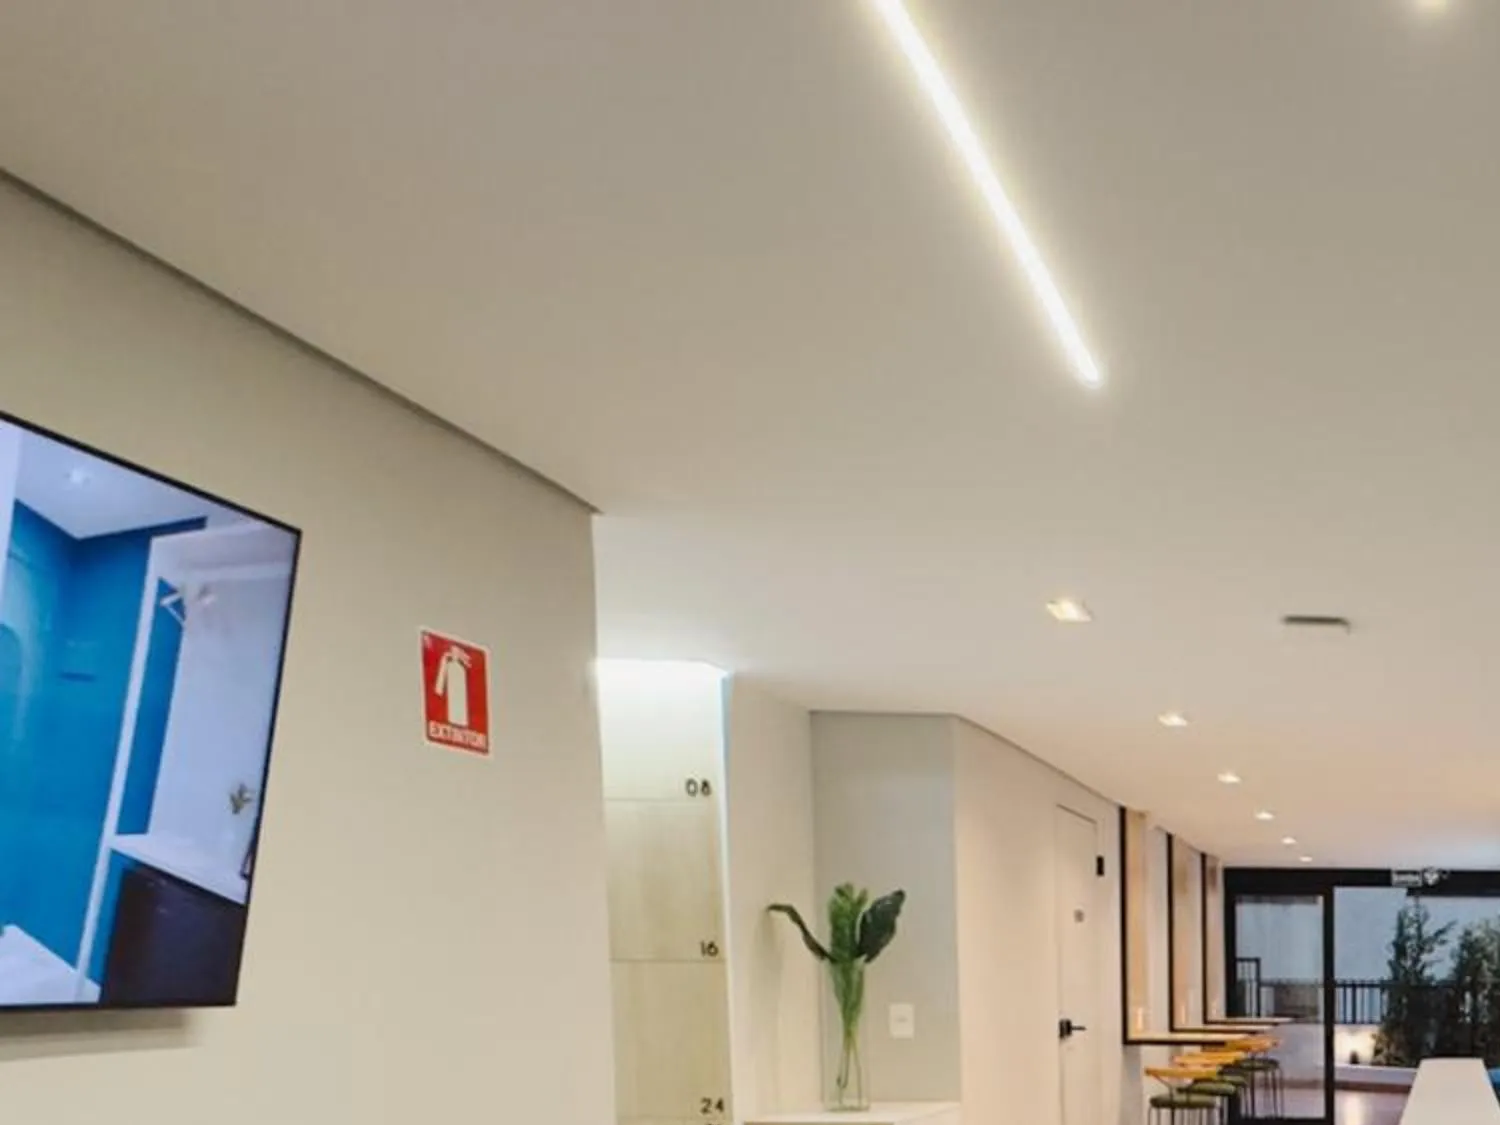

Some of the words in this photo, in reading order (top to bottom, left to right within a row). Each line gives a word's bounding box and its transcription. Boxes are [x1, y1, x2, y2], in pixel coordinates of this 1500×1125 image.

[685, 778, 712, 797] 08
[700, 940, 719, 957] 16
[701, 1097, 724, 1113] 24
